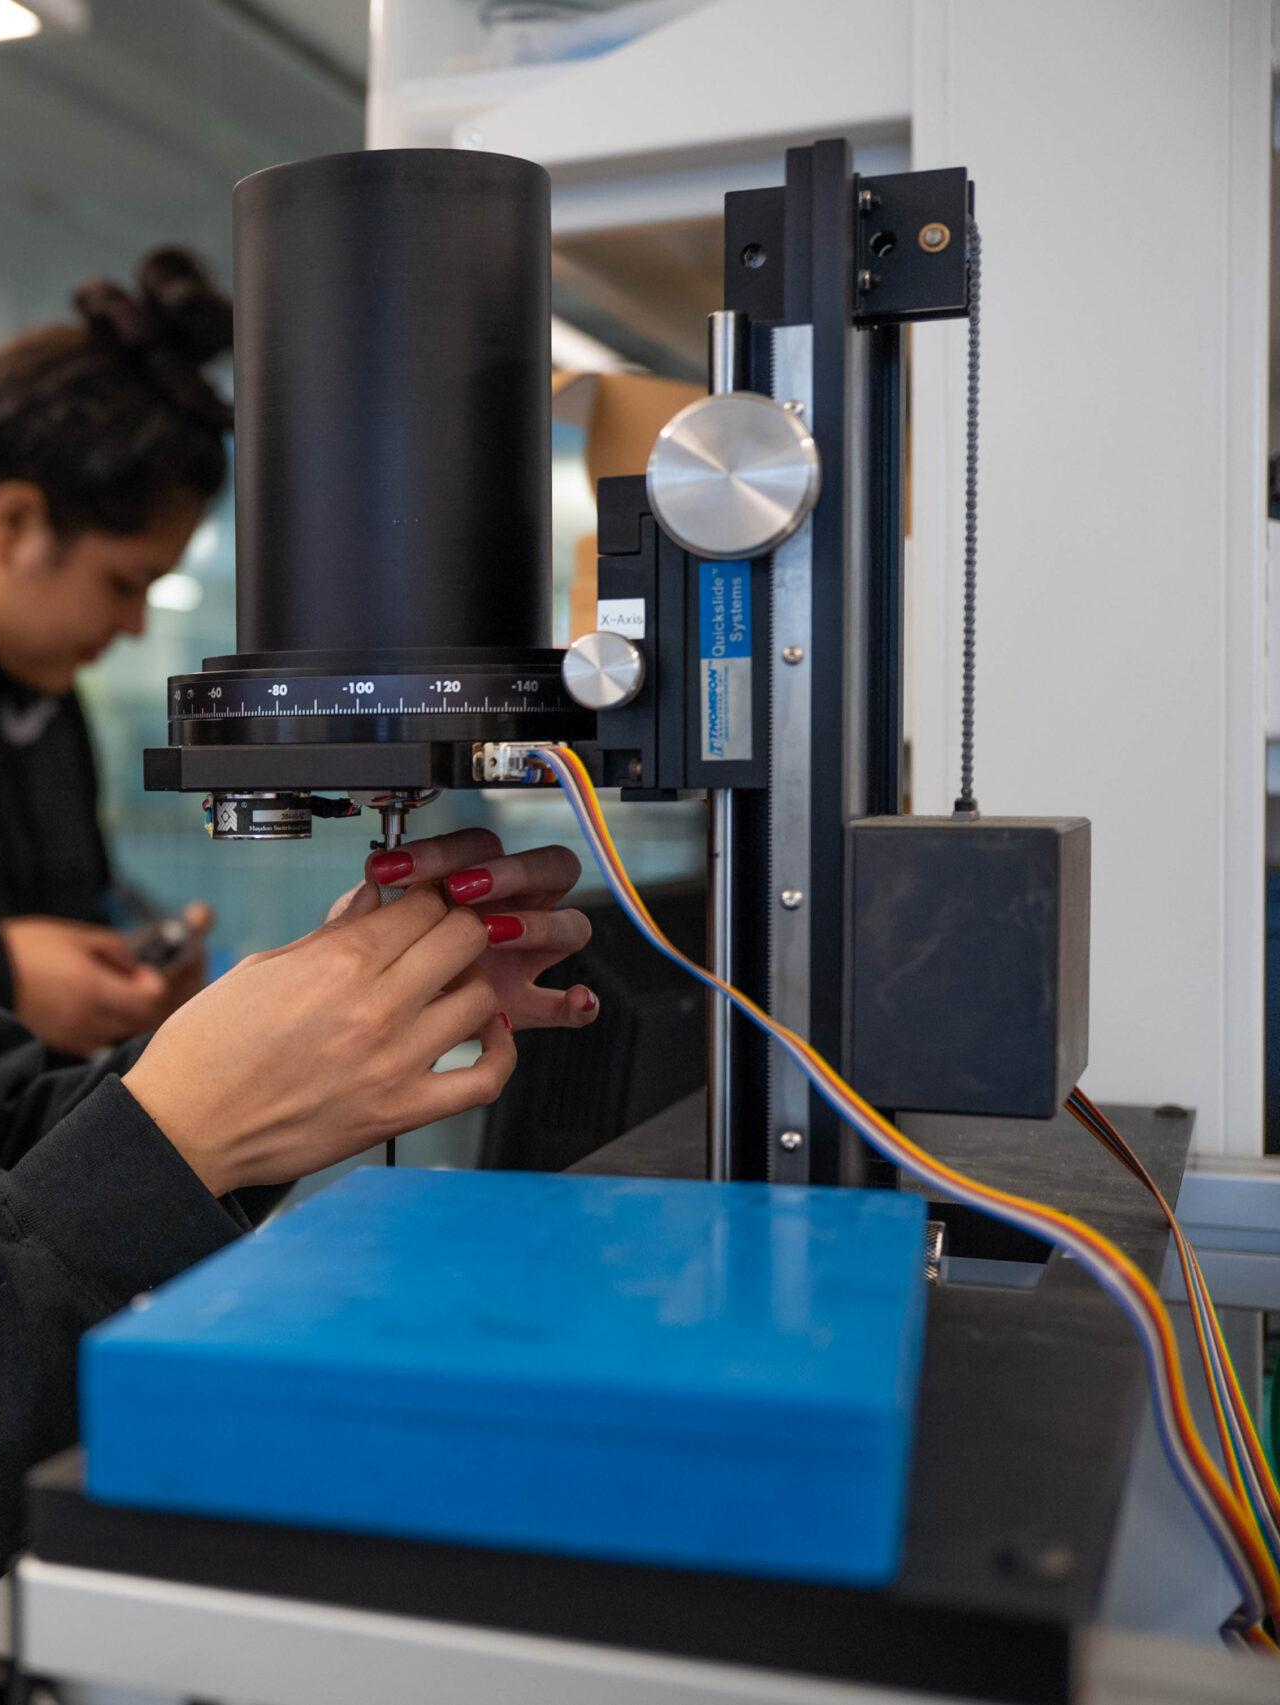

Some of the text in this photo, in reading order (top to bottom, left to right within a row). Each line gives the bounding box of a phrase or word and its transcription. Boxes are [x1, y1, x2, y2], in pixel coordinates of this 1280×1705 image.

[600, 613, 643, 626] X-Axis
[712, 577, 725, 657] Quickslide
[729, 576, 746, 642] Systems
[207, 686, 222, 699] -60
[267, 683, 288, 697] -80
[342, 681, 375, 694] -100
[429, 680, 462, 693] -120
[511, 680, 539, 693] -140
[707, 668, 718, 740] THOMSON
